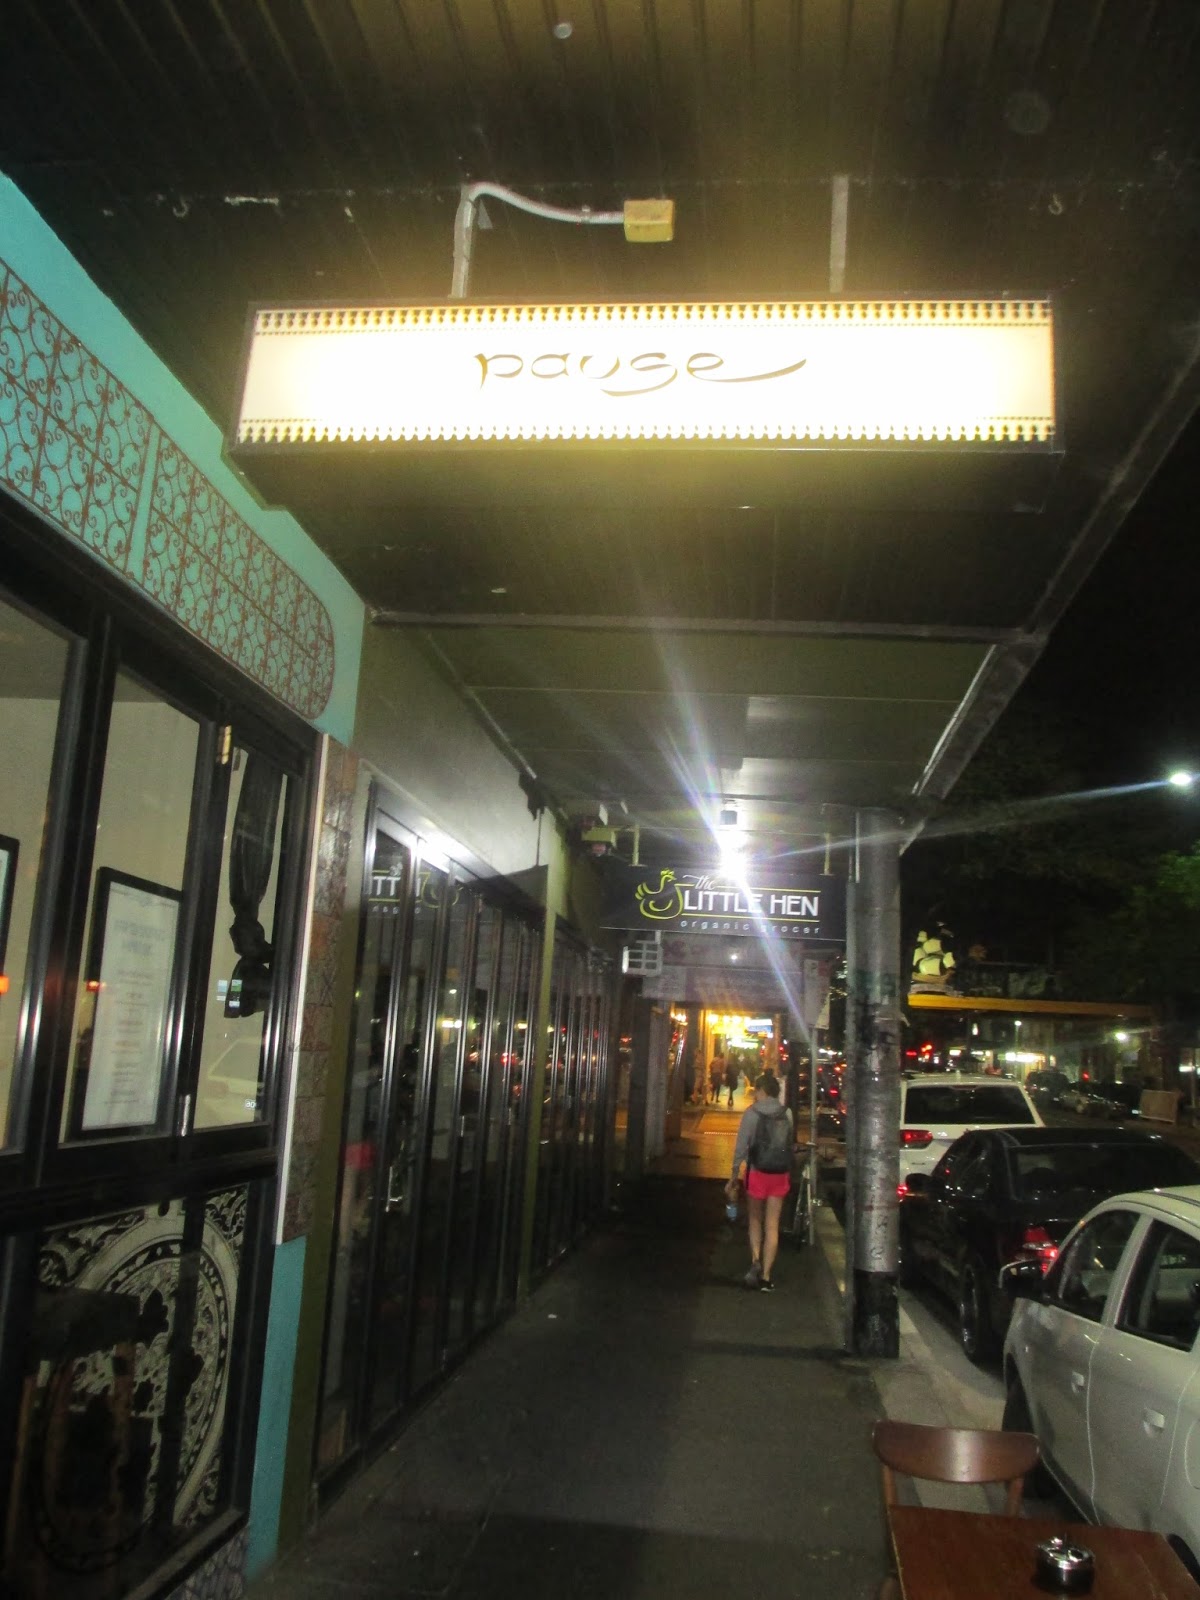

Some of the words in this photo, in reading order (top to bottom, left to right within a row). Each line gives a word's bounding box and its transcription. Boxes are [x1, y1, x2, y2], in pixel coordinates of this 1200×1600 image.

[473, 351, 807, 397] pause
[684, 889, 763, 913] LITTLE
[770, 894, 818, 917] HEN
[680, 920, 750, 931] organic
